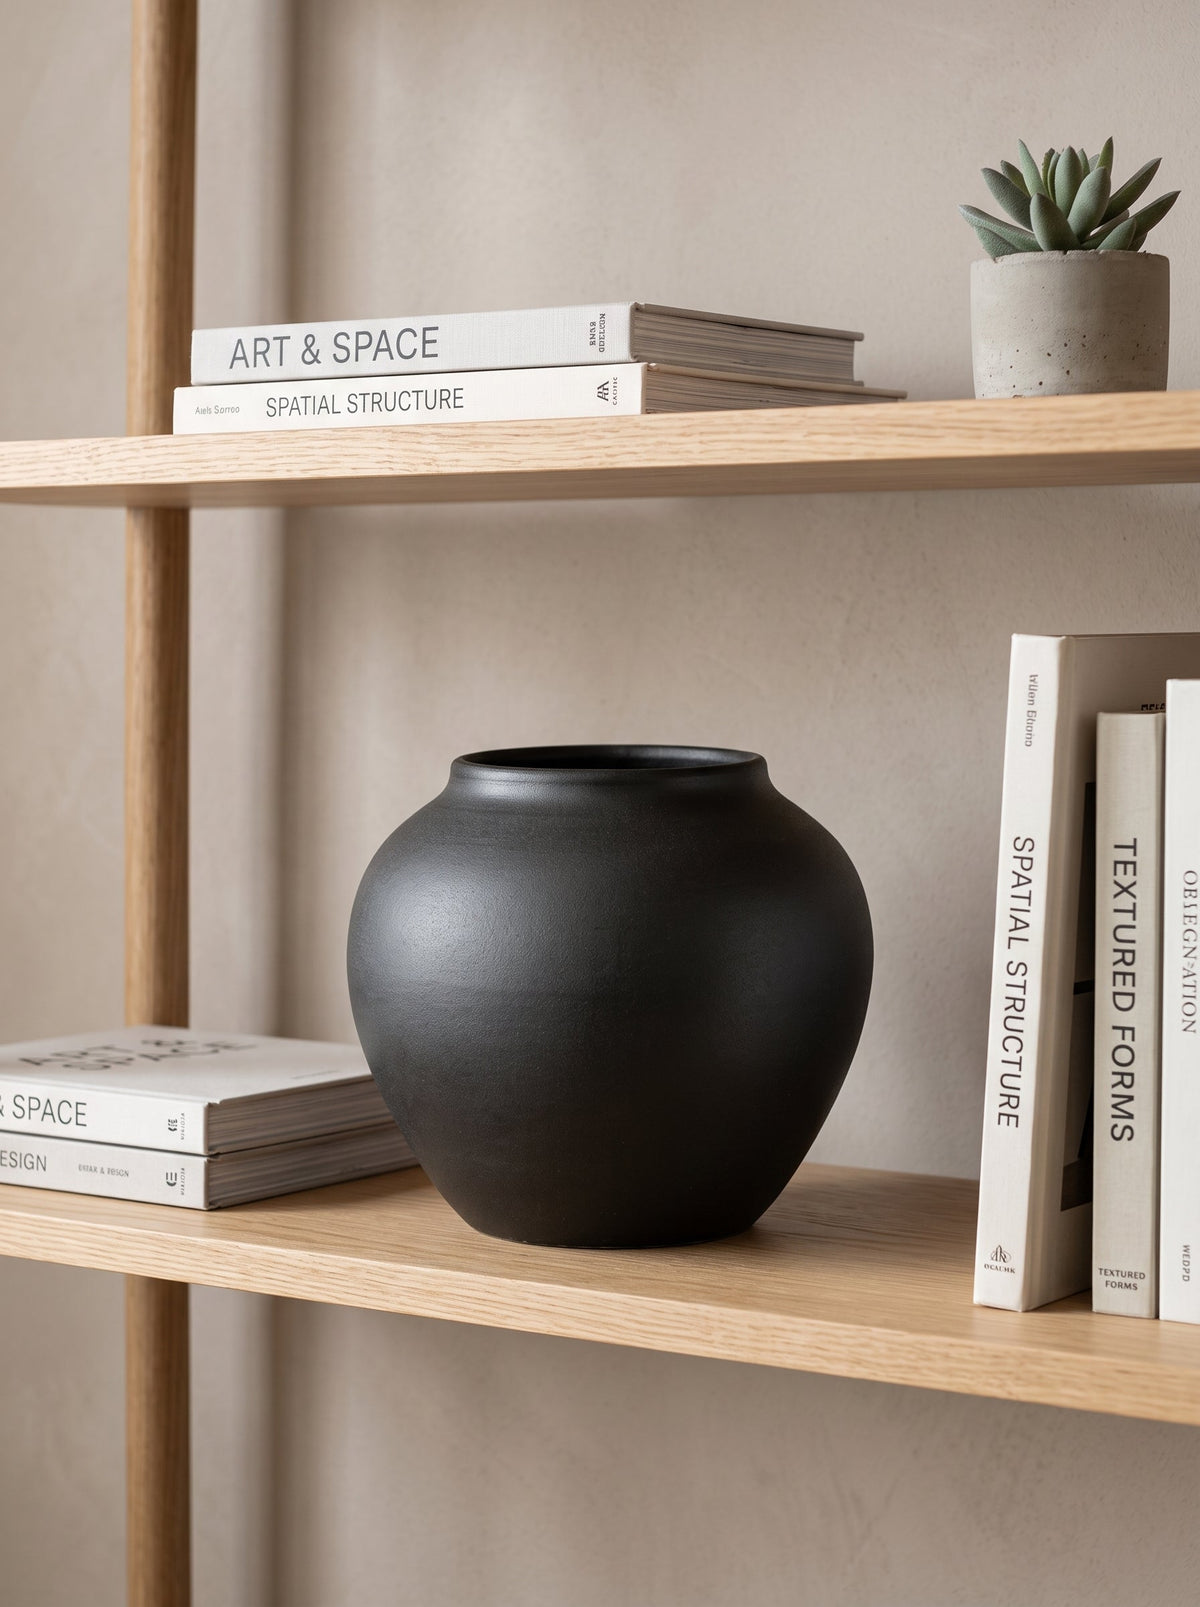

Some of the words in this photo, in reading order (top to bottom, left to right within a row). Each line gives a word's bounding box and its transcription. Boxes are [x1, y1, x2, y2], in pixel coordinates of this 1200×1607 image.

[229, 336, 290, 369] ART
[301, 333, 322, 365] &
[332, 326, 439, 361] SPACE
[266, 394, 341, 418] SPATIAL
[347, 387, 464, 413] STRUCTURE
[1007, 836, 1034, 950] SPATIAL
[1111, 837, 1138, 1013] TEXTURED
[997, 960, 1028, 1129] STRUCTURE
[1110, 1025, 1136, 1142] FORMS
[12, 1094, 87, 1127] SPACE
[1098, 1268, 1146, 1281] TEXTURED
[1105, 1279, 1139, 1291] FORMS
